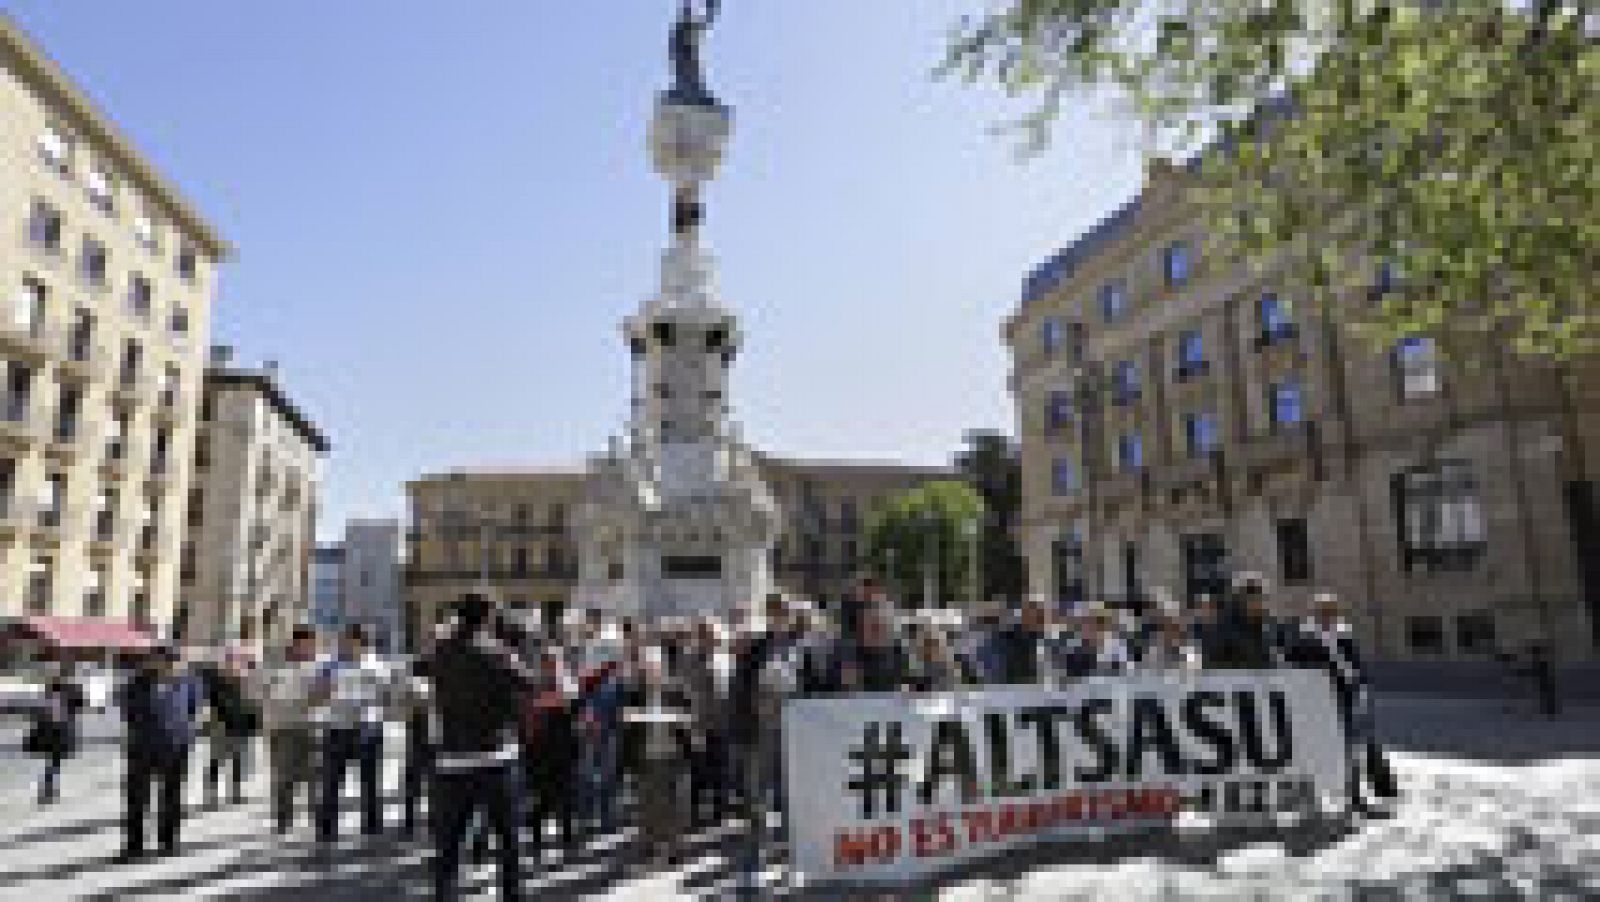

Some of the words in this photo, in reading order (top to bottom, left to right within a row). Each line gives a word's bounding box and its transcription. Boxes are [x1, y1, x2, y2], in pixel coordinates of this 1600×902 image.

[847, 690, 1294, 819] #ALTSASU
[834, 828, 900, 871] NO
[908, 817, 954, 857] ES
